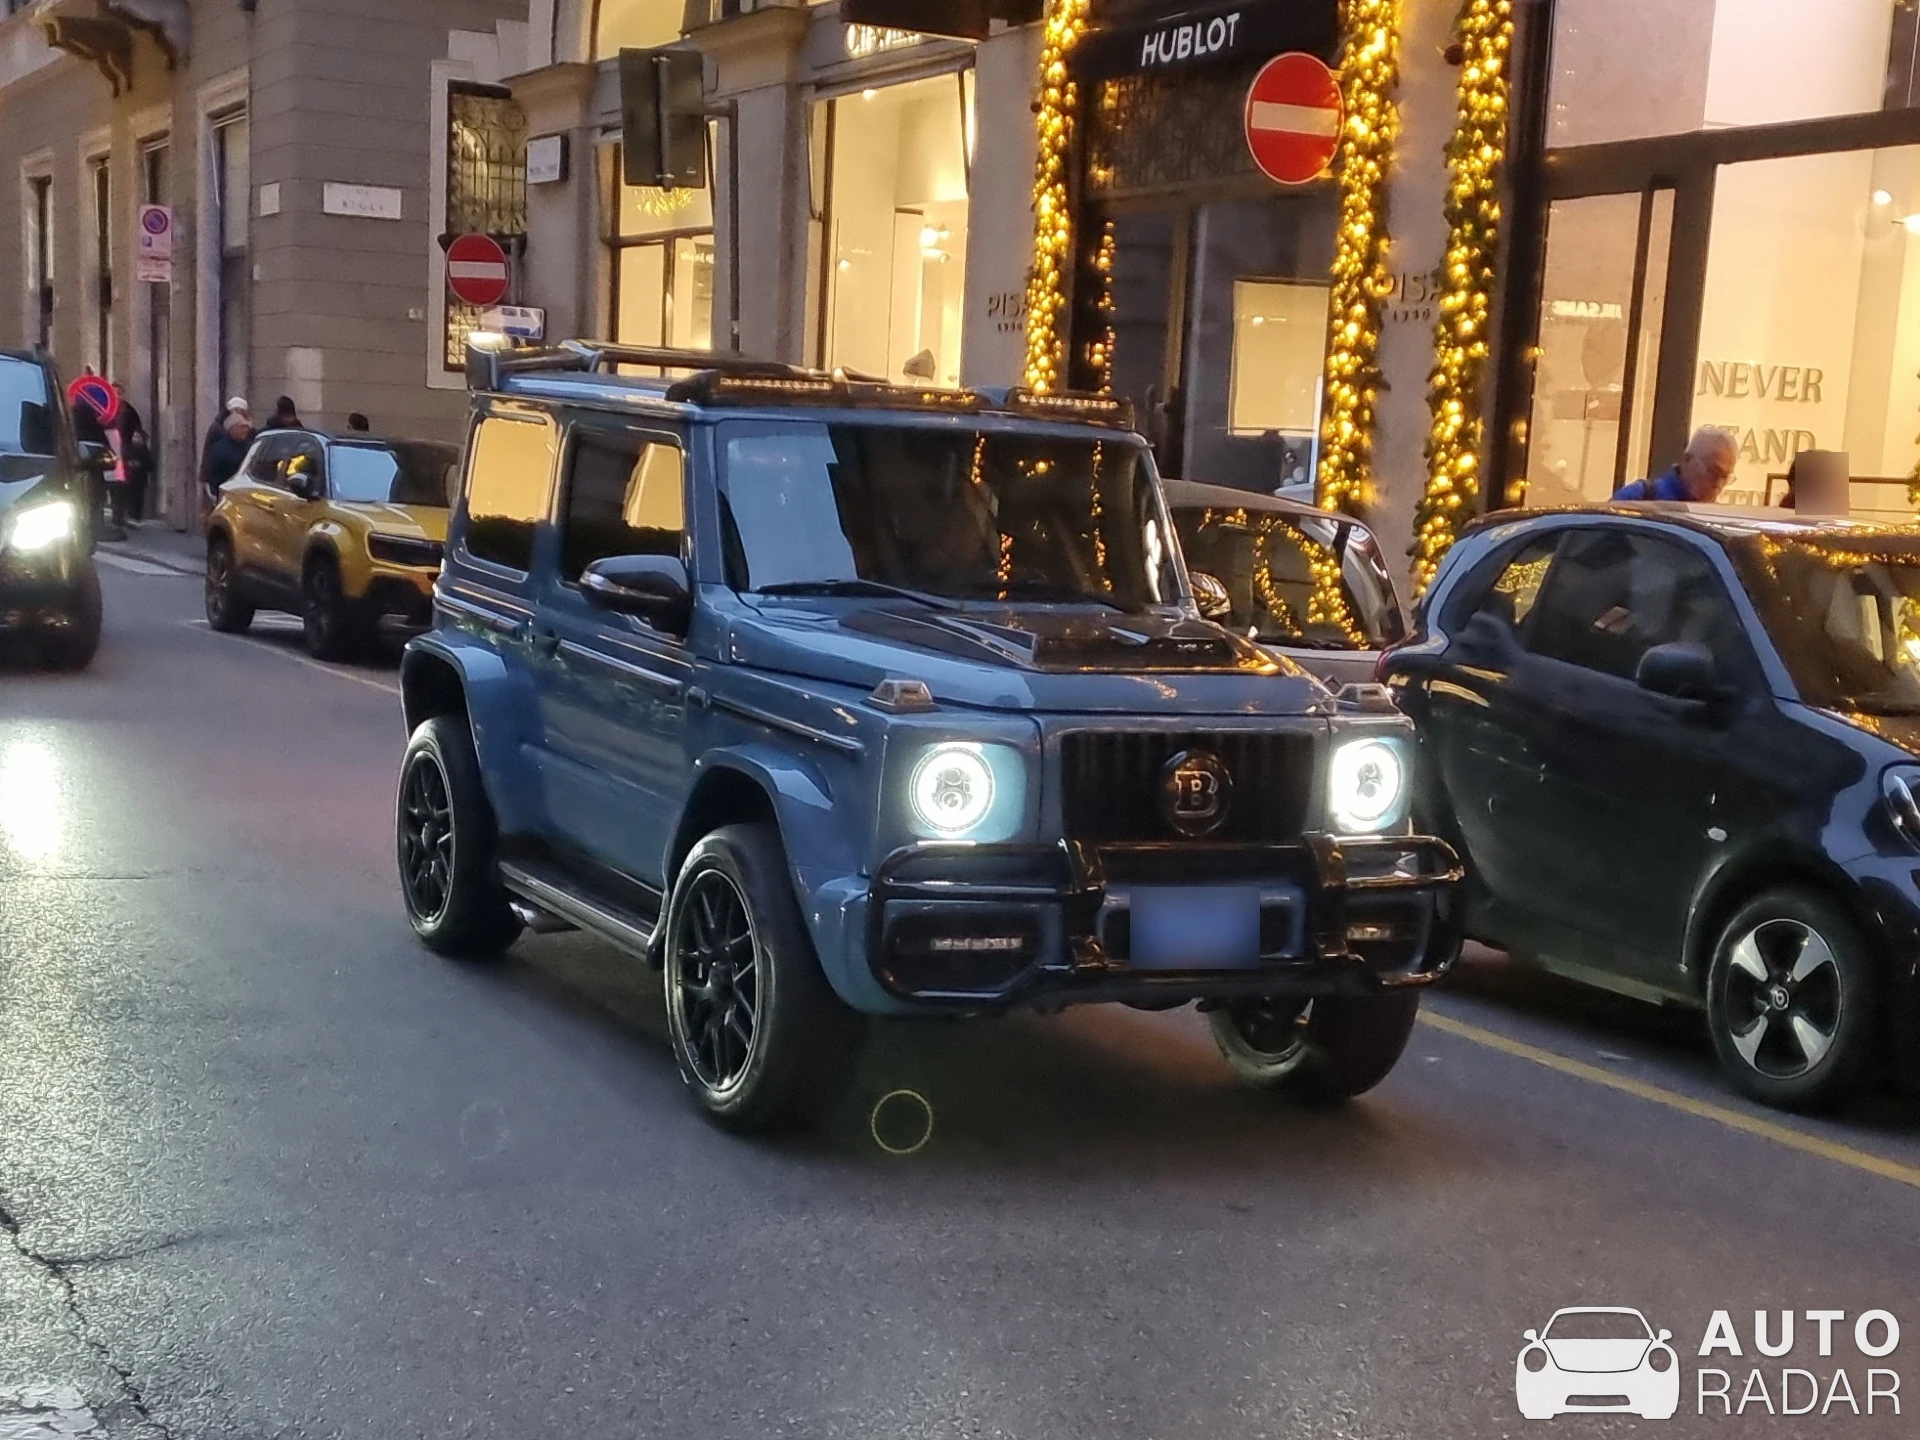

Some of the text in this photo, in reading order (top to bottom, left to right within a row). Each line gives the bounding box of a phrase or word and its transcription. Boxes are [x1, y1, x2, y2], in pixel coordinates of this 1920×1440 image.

[1141, 12, 1240, 66] HUBLOT
[1696, 360, 1824, 404] NEVER
[1174, 769, 1219, 817] B
